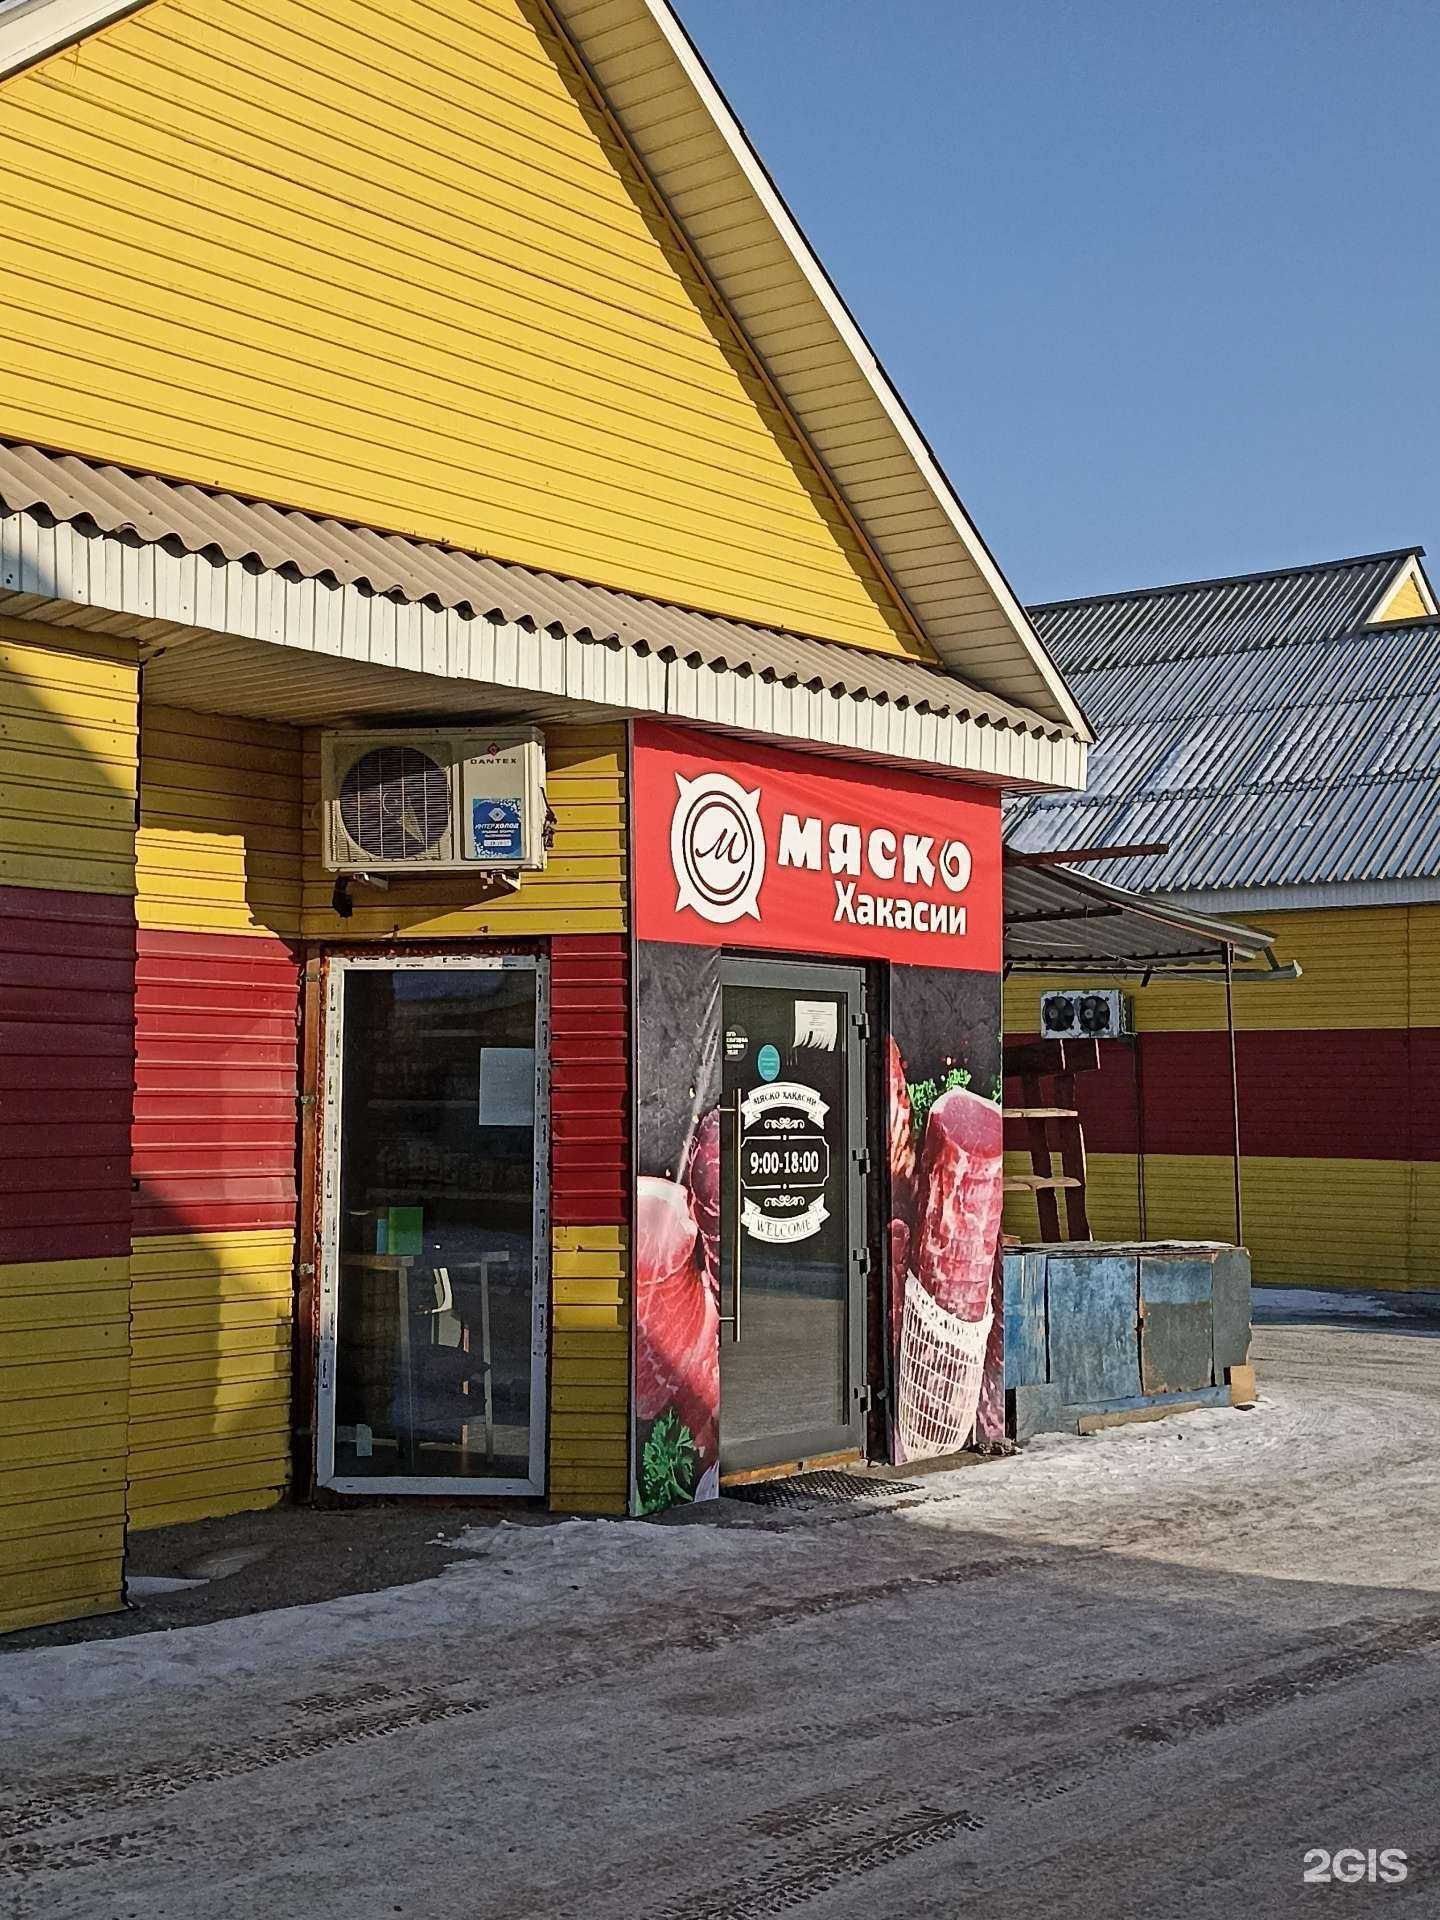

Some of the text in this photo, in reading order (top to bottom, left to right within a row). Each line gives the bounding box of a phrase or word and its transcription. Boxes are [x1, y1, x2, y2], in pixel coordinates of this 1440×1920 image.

[833, 880, 967, 935] Хакасии
[753, 1091, 817, 1106] МЯСКО ХАКАСИИ
[750, 1151, 819, 1174] 9:00-18:00
[757, 1219, 812, 1238] WELCOME
